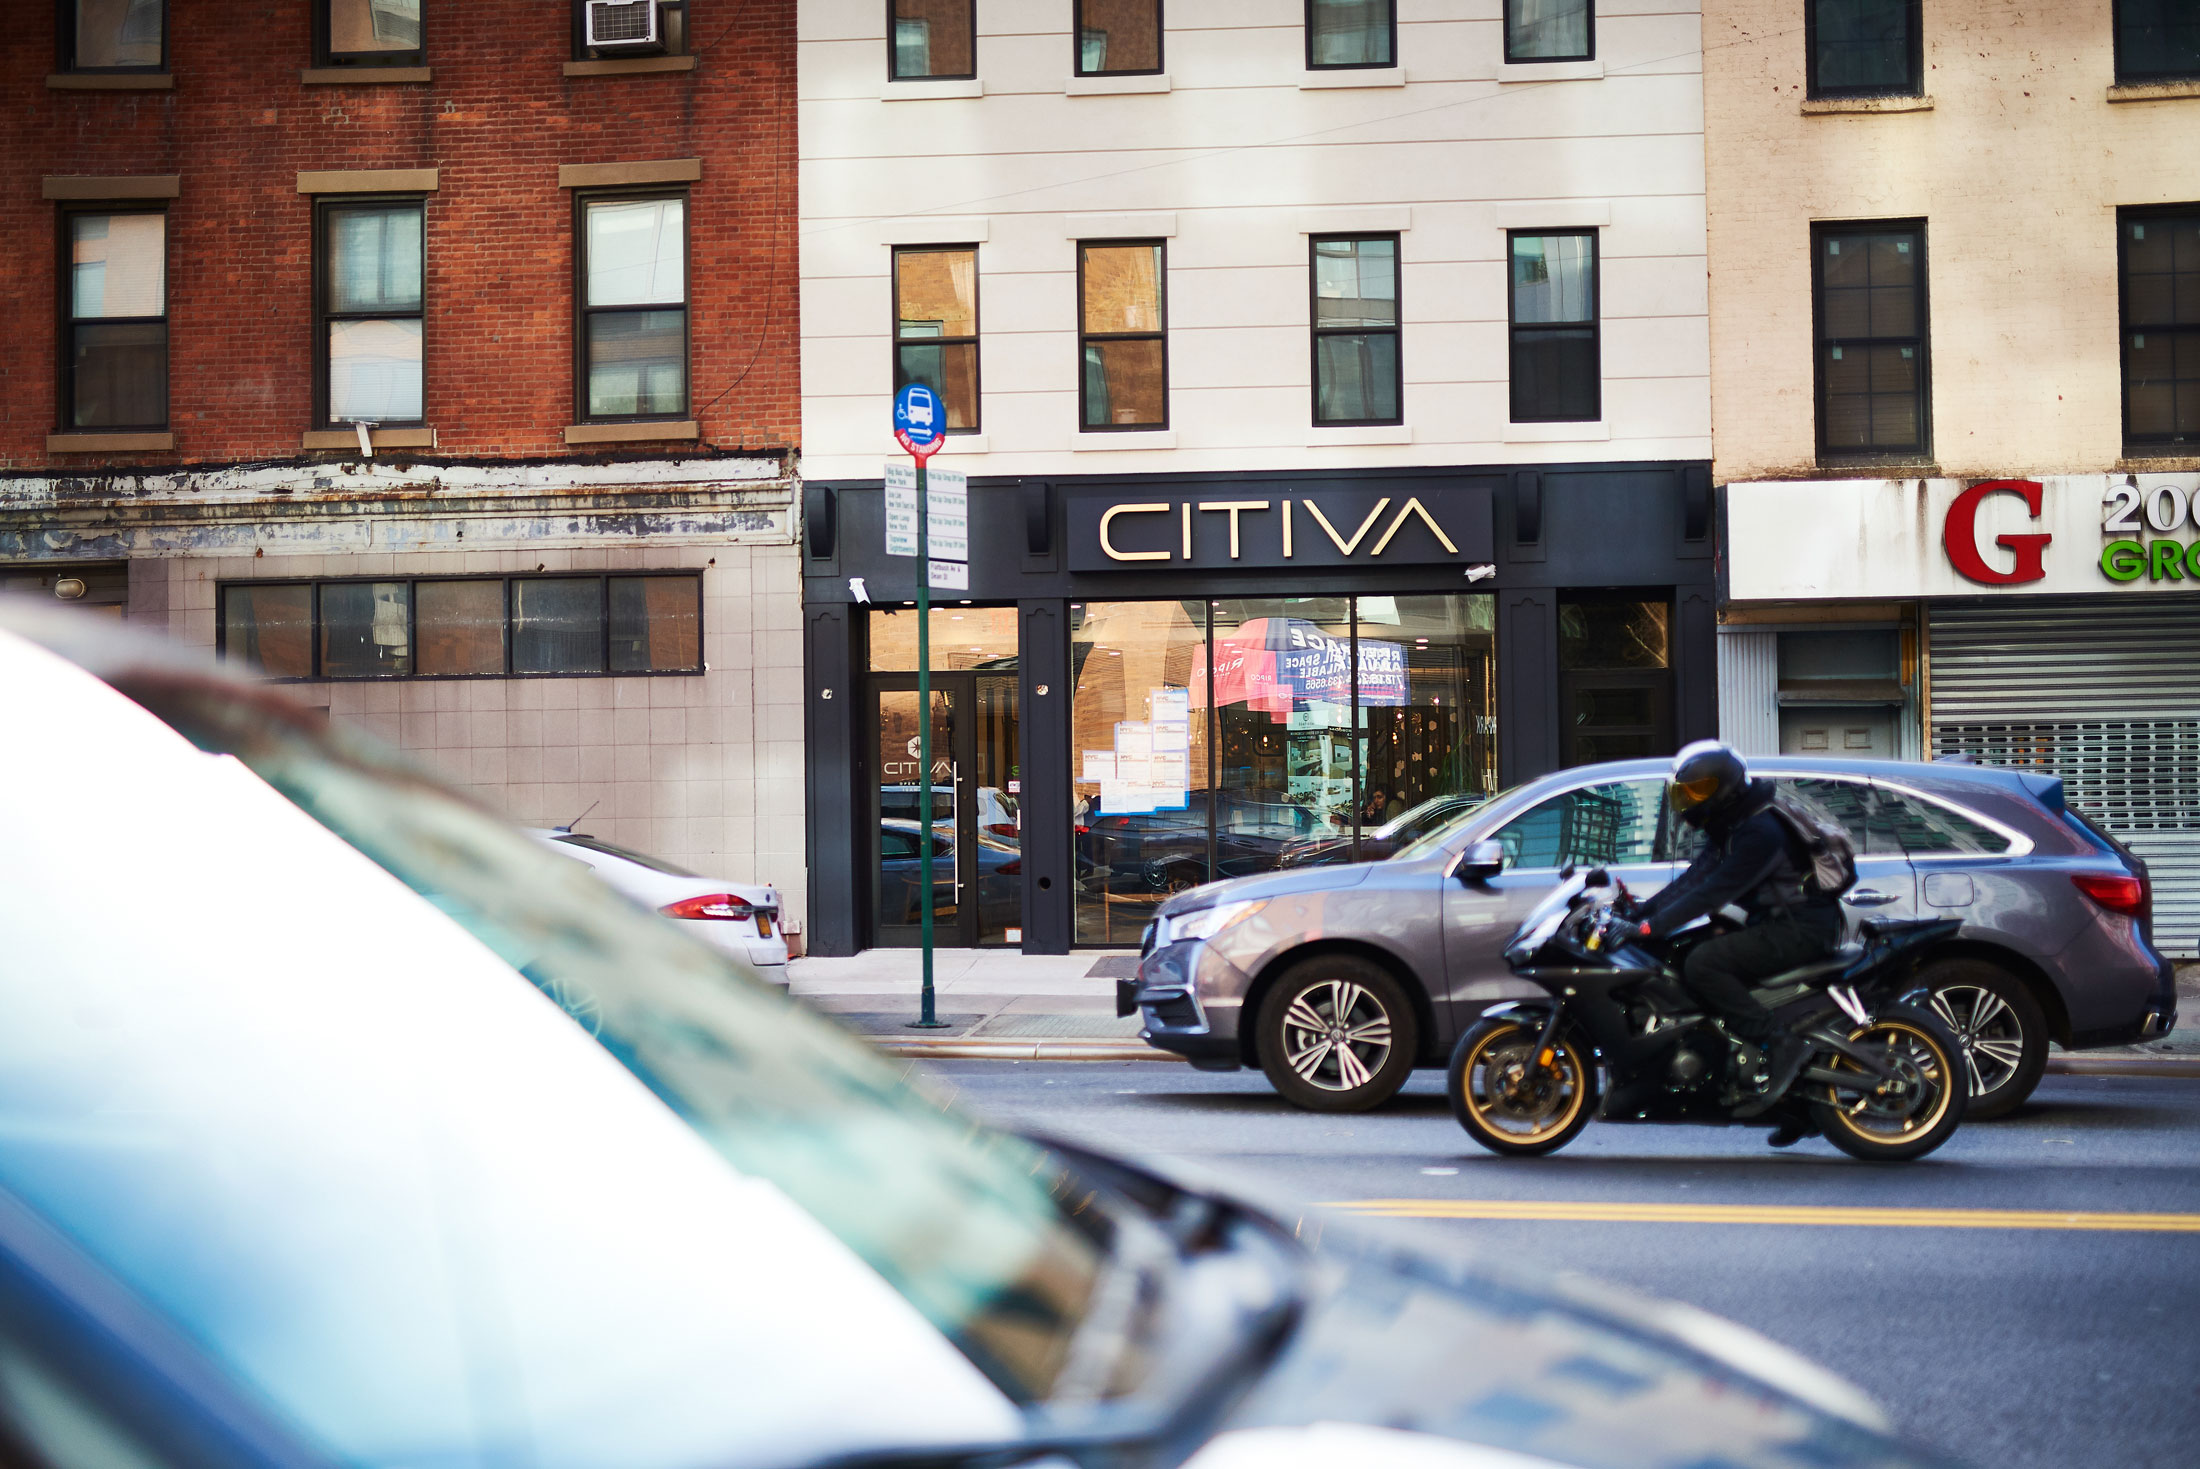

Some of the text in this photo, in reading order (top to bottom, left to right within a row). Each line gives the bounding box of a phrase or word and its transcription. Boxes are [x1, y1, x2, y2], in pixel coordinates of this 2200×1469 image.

[900, 433, 910, 446] NO
[911, 437, 942, 453] STANDING
[1100, 497, 1459, 561] CITIVA
[1944, 479, 2053, 585] G
[2104, 484, 2200, 532] 20
